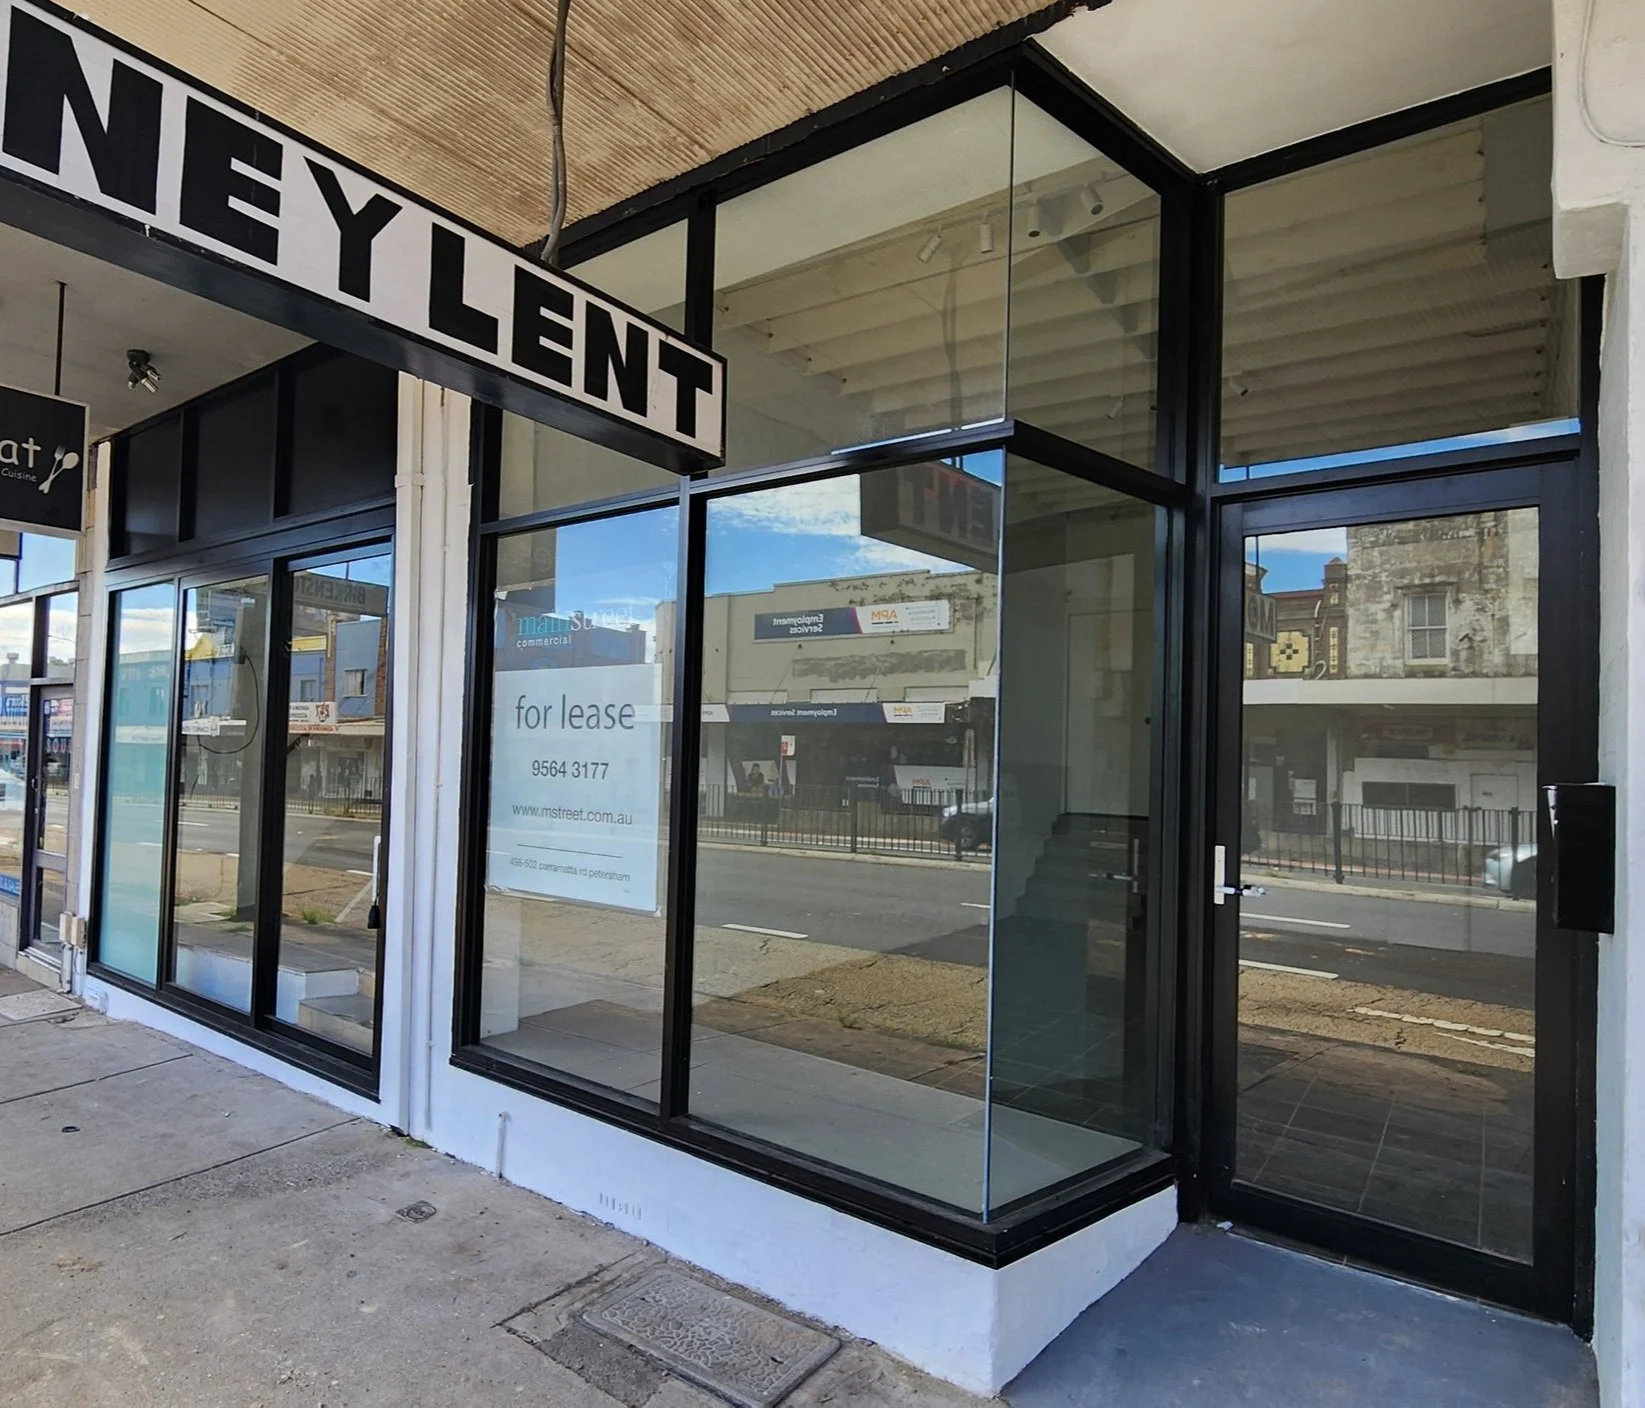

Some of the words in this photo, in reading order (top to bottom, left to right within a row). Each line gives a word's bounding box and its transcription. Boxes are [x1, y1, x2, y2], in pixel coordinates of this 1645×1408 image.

[0, 437, 41, 469] at
[1, 468, 37, 482] Cuisine
[516, 635, 572, 648] commercial
[515, 695, 552, 731] for
[561, 694, 635, 731] lease
[532, 760, 567, 778] 9564
[571, 762, 609, 780] 3177
[512, 805, 633, 826] www.mstreet.com.au
[539, 862, 578, 876] parramatta
[588, 869, 631, 882] petersham
